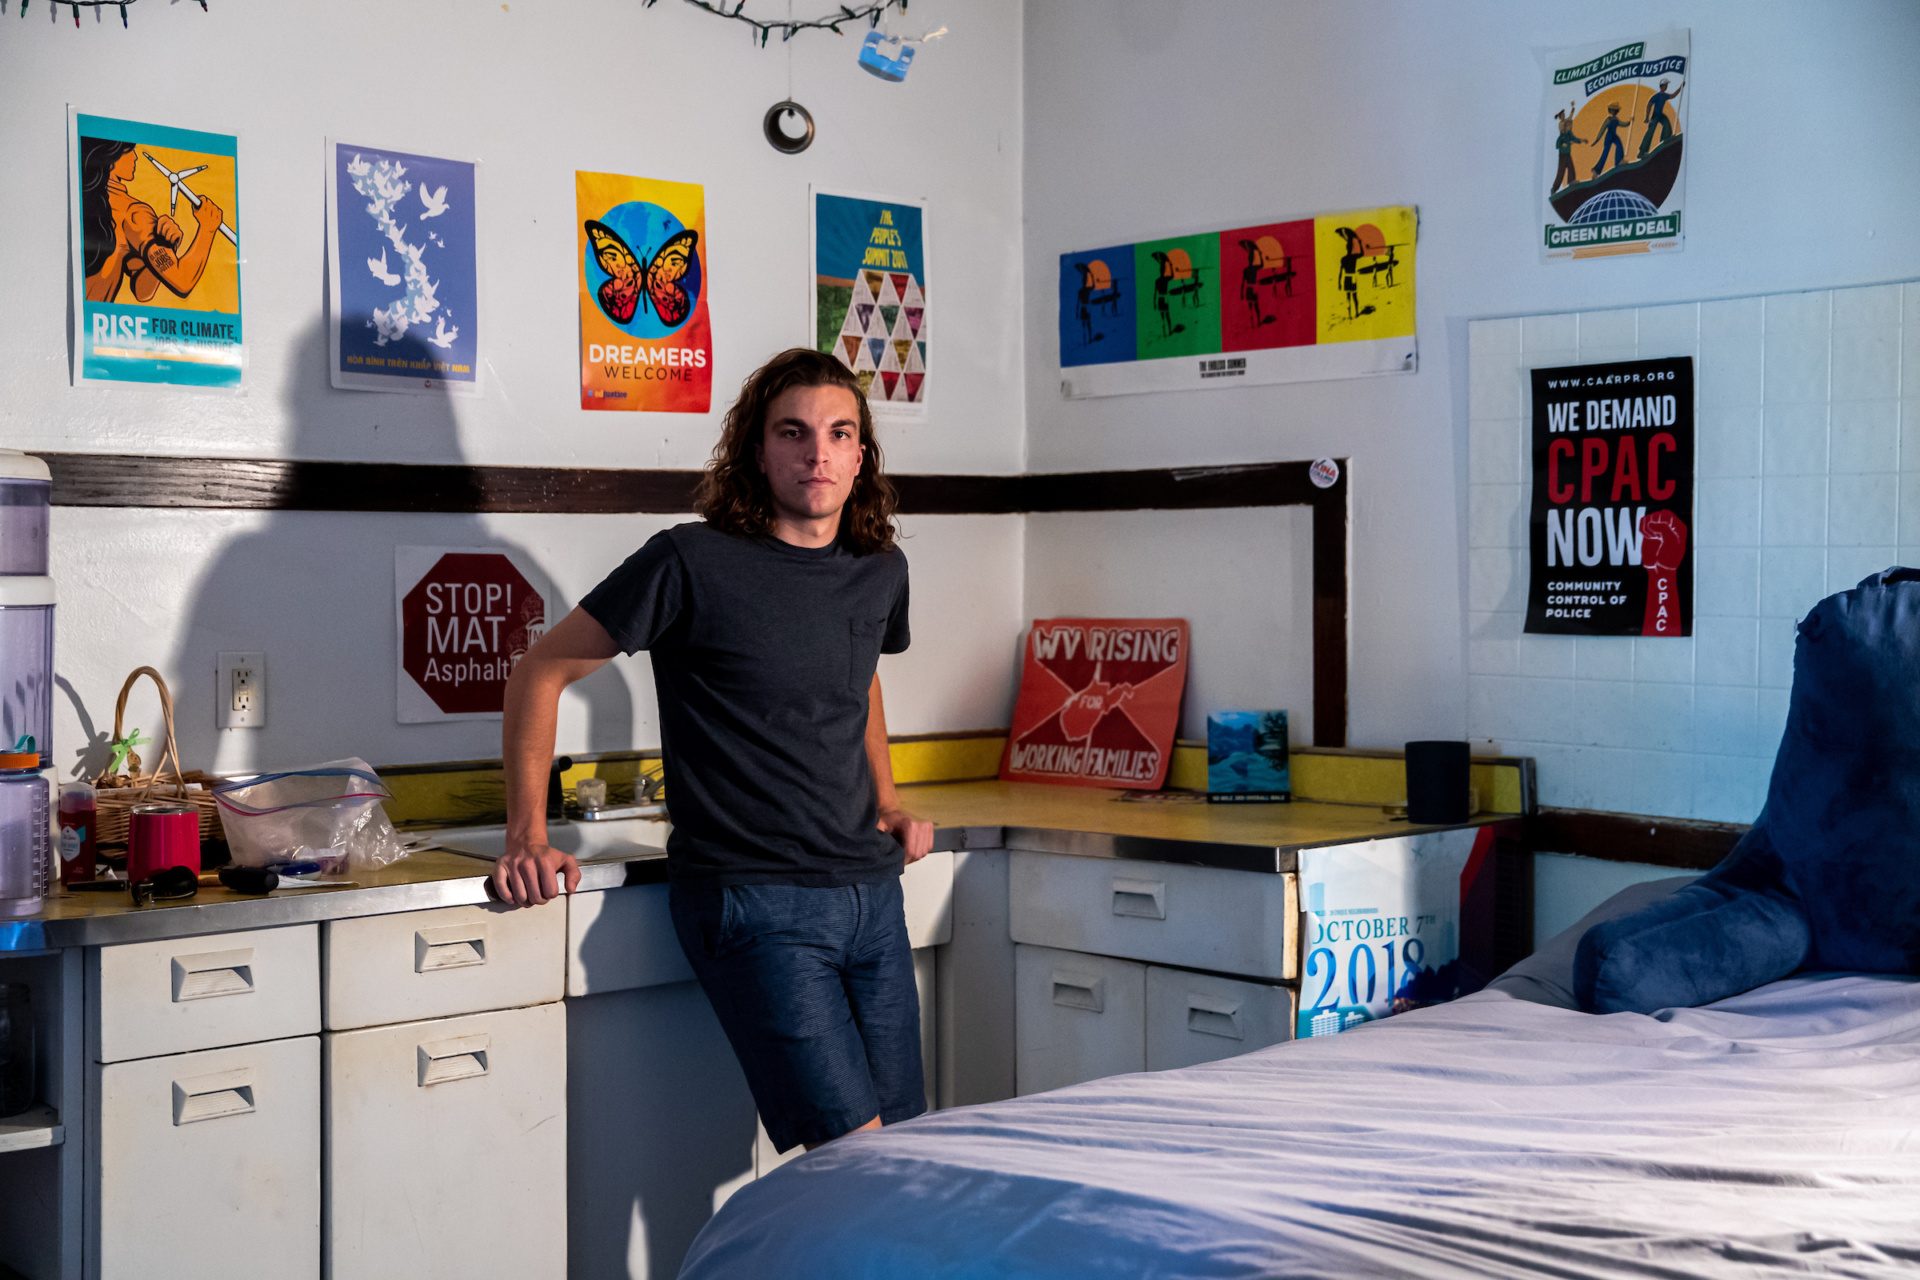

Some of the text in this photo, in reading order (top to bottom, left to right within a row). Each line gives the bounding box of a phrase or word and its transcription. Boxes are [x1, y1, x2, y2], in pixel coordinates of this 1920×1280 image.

[1555, 45, 1641, 82] CLIMATE JUSTICE
[1586, 59, 1683, 92] ECONOMIC JUSTICE
[880, 209, 893, 226] THE
[1551, 220, 1674, 244] GREEN NEW DEAL
[862, 246, 890, 267] SUMMIT
[93, 313, 238, 346] RISE FOR CLIMATE,
[589, 344, 706, 368] DREAMERS
[604, 366, 692, 382] WELCOME
[1548, 371, 1675, 389] WWW.CAARPR.ORG
[1547, 395, 1676, 432] WE DEMAND
[1548, 432, 1677, 504] CPAC
[1547, 507, 1646, 567] NOW
[426, 582, 511, 614] STOP!
[1547, 581, 1621, 591] COMMUNITY
[1547, 595, 1627, 605] CONTROL OF
[1545, 609, 1592, 618] POLICE
[1656, 578, 1668, 631] CPAC
[427, 616, 506, 653] MAT
[1035, 629, 1179, 662] WV RISING
[424, 657, 509, 687] Asphalt
[1079, 695, 1103, 709] FOR
[1012, 743, 1158, 779] WORKING FAMILIES
[1306, 938, 1424, 1010] 2018
